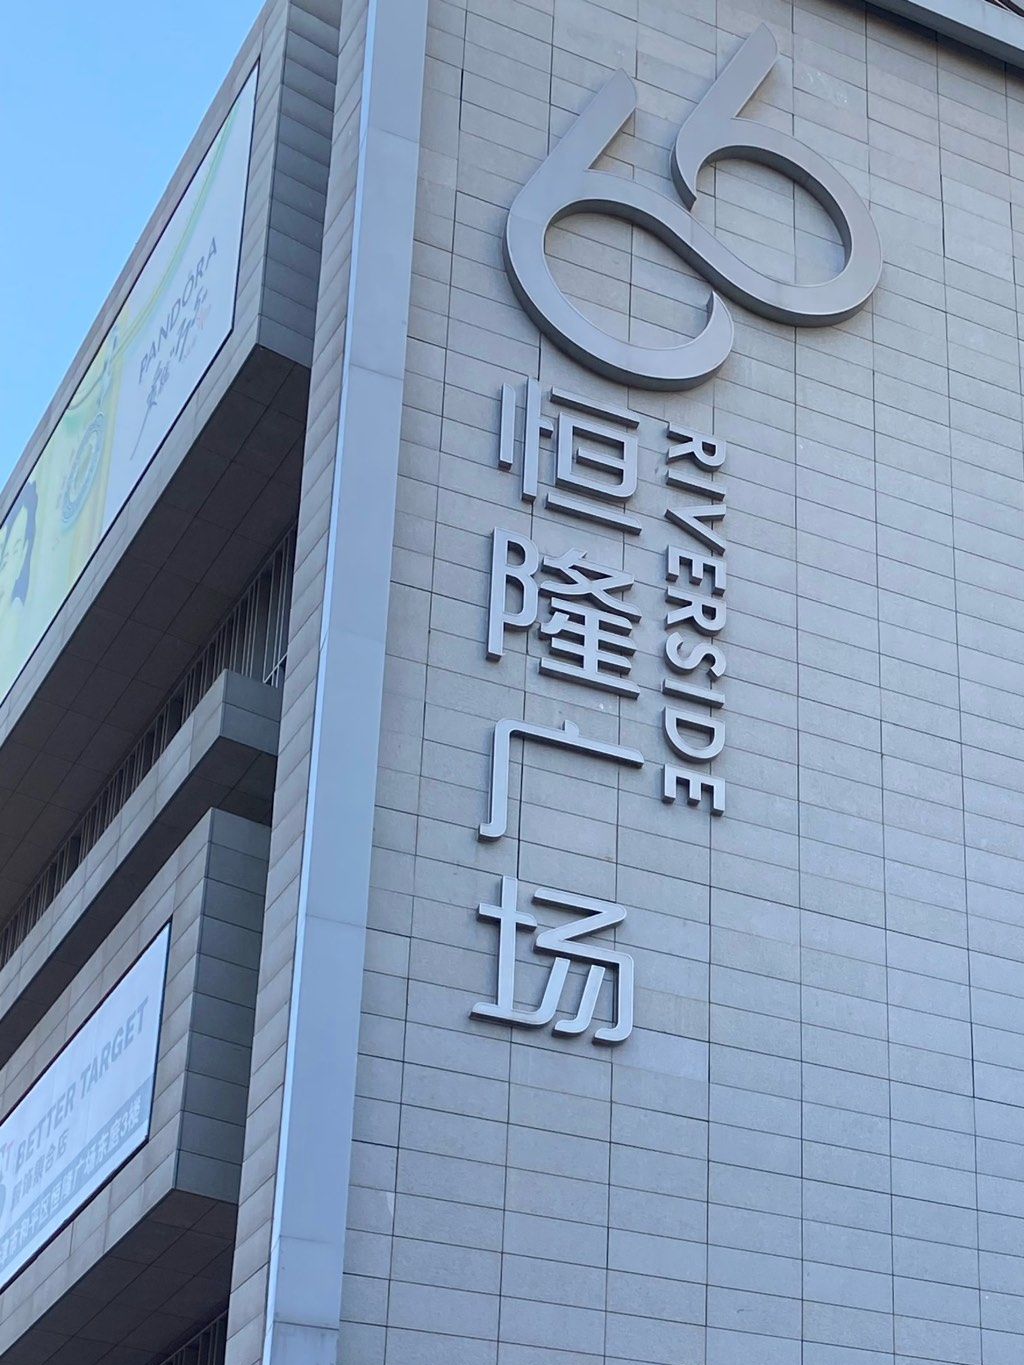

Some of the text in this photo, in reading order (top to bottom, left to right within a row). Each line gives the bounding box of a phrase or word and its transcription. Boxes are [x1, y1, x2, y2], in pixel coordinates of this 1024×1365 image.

[138, 237, 218, 384] PANDORA
[503, 21, 884, 393] 66
[469, 375, 643, 1046] 恒隆广场
[662, 420, 727, 817] RIVERSIDE
[15, 995, 149, 1174] BETTER TARGET
